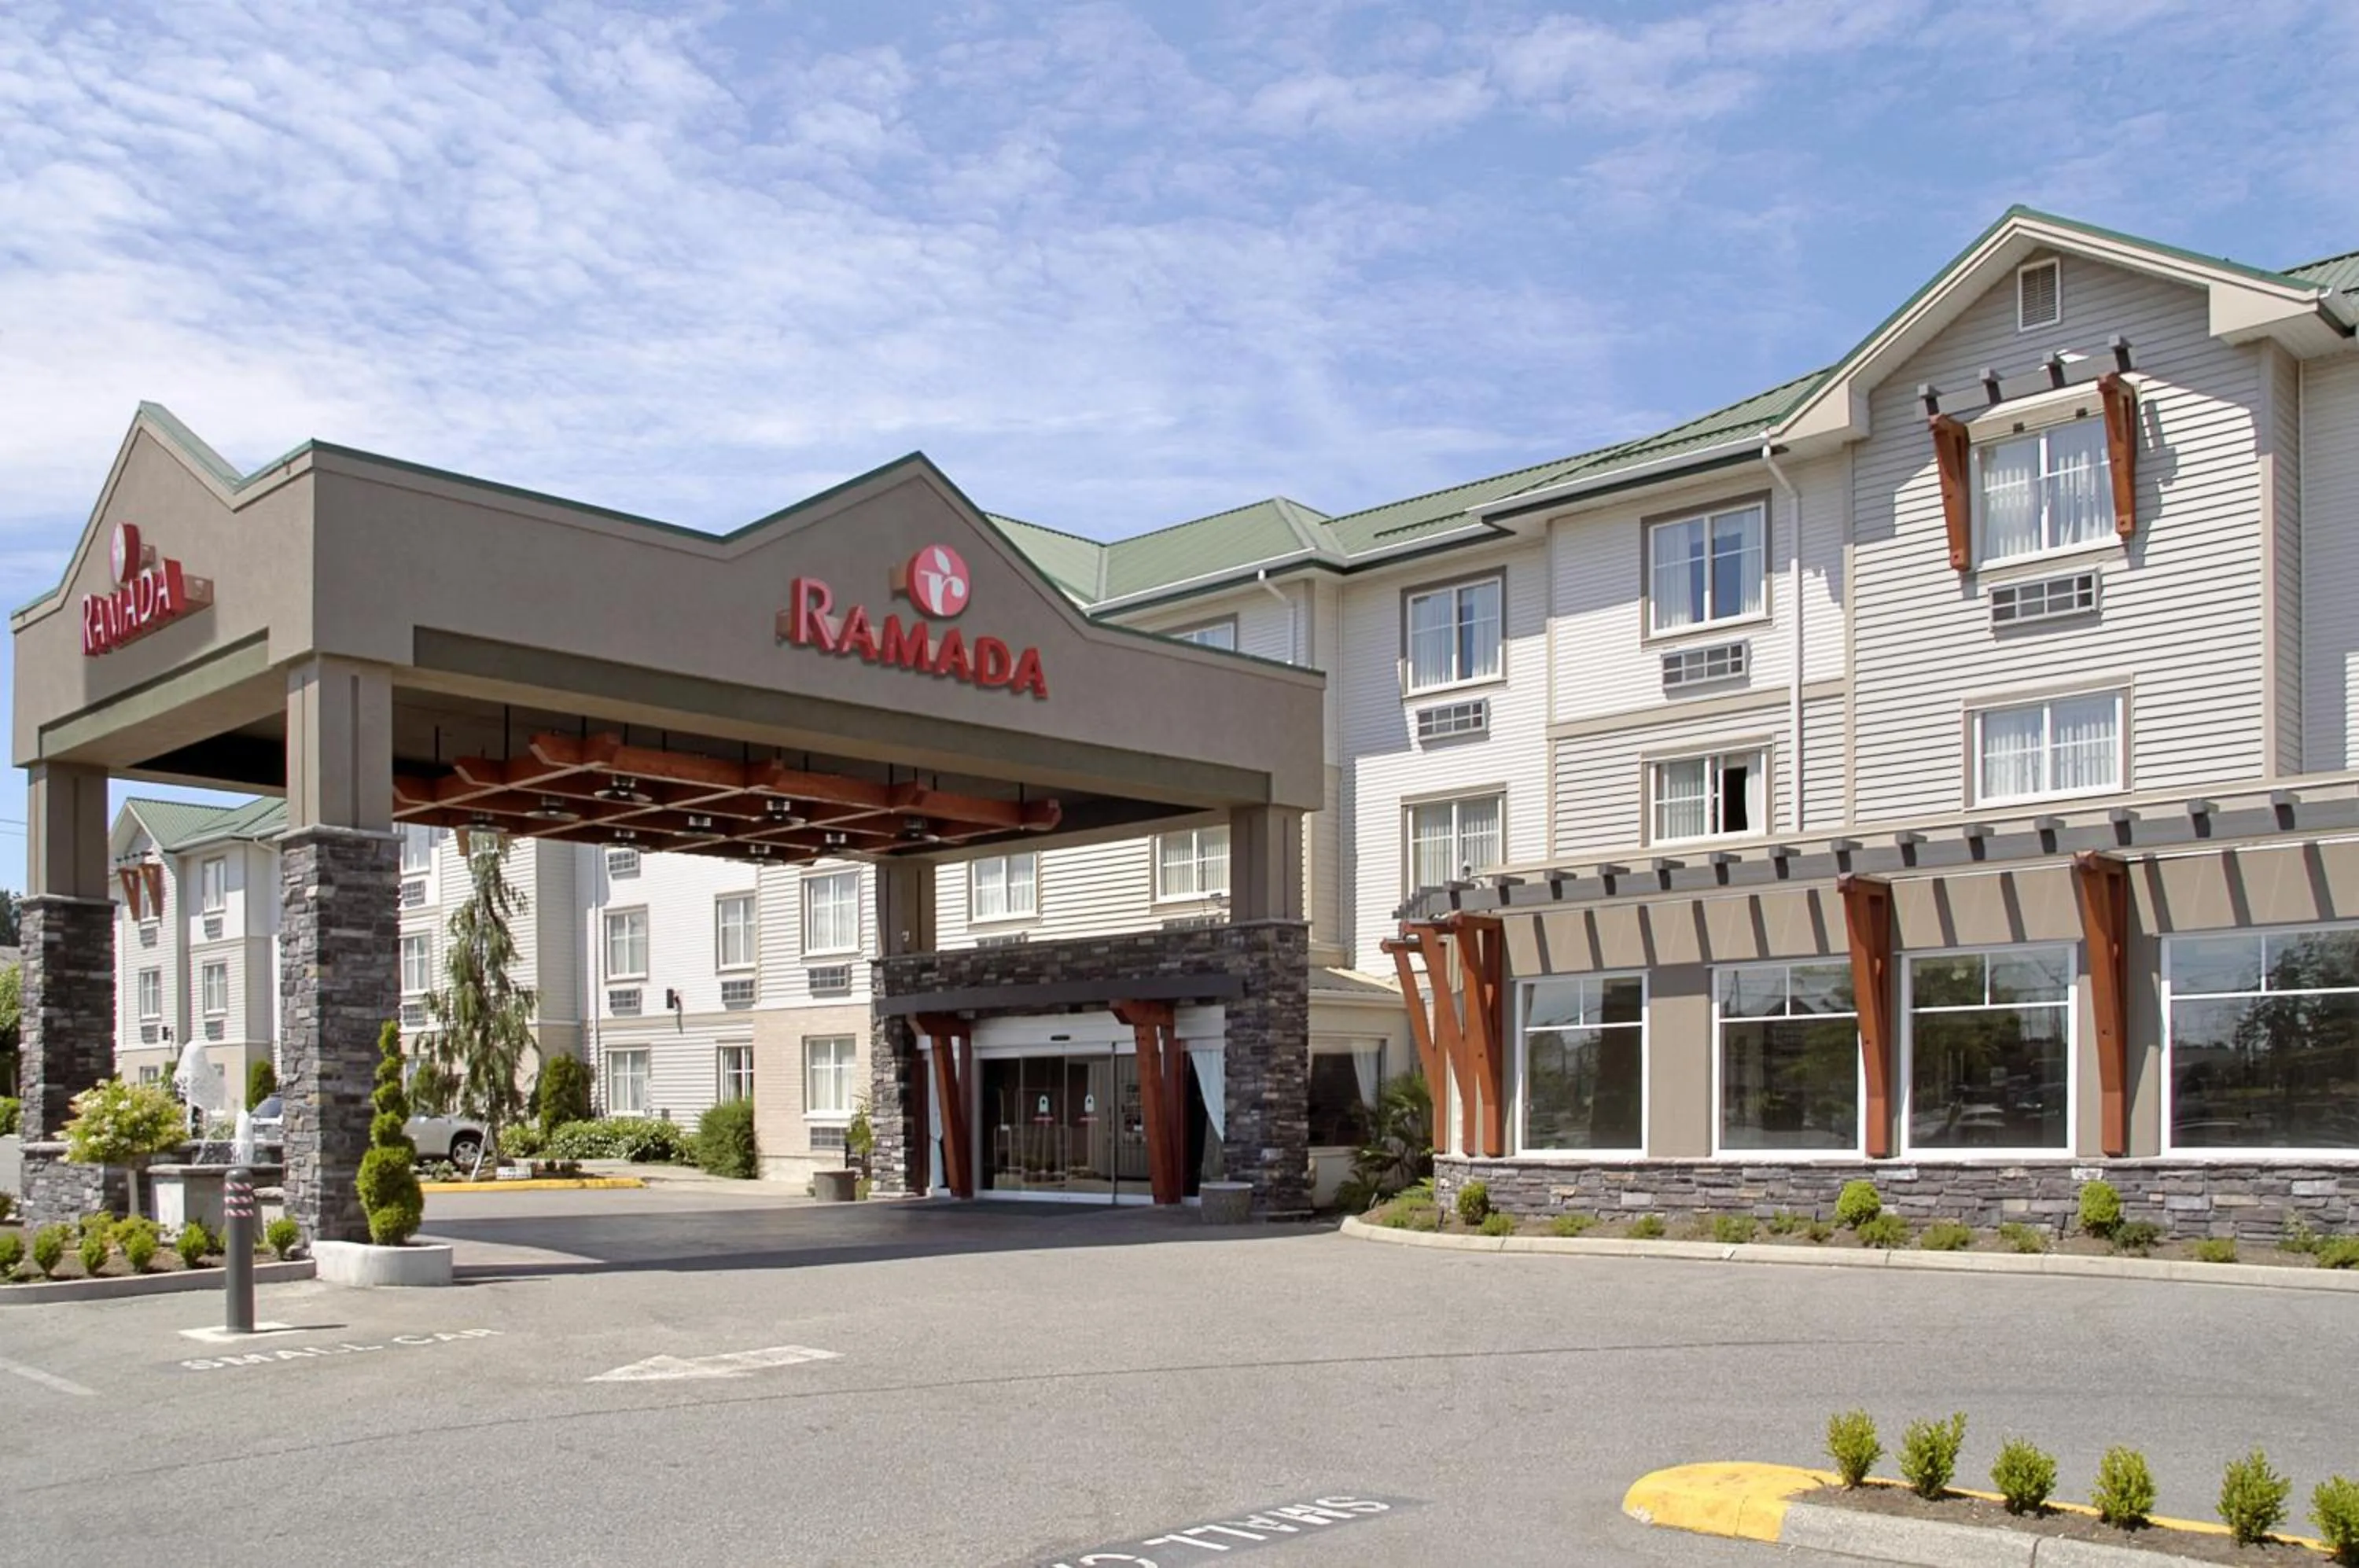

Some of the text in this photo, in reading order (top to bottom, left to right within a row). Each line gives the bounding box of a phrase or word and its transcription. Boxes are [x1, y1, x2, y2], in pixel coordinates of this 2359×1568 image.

[791, 577, 1047, 698] RAMADA
[180, 1342, 383, 1371] SMALL
[1143, 1495, 1393, 1552] SMALL
